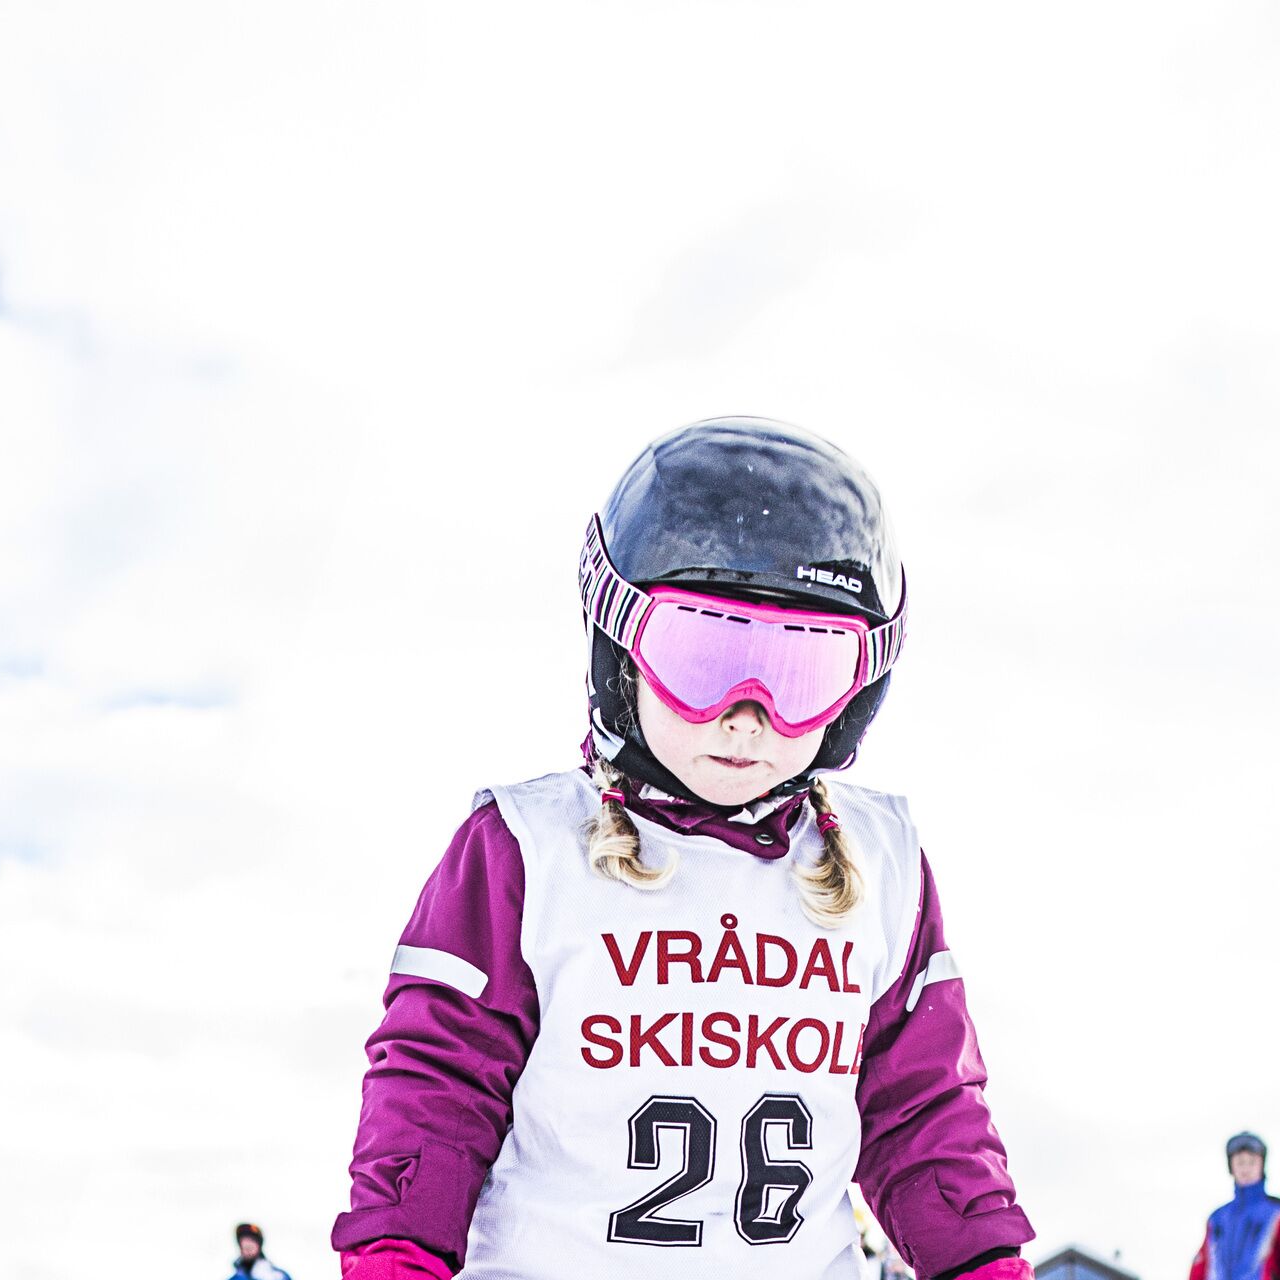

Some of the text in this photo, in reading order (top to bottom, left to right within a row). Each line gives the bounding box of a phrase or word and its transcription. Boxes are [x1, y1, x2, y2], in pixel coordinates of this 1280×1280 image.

[797, 566, 862, 593] HEAD
[601, 913, 861, 994] VRÅDAL
[607, 1092, 813, 1247] 26
